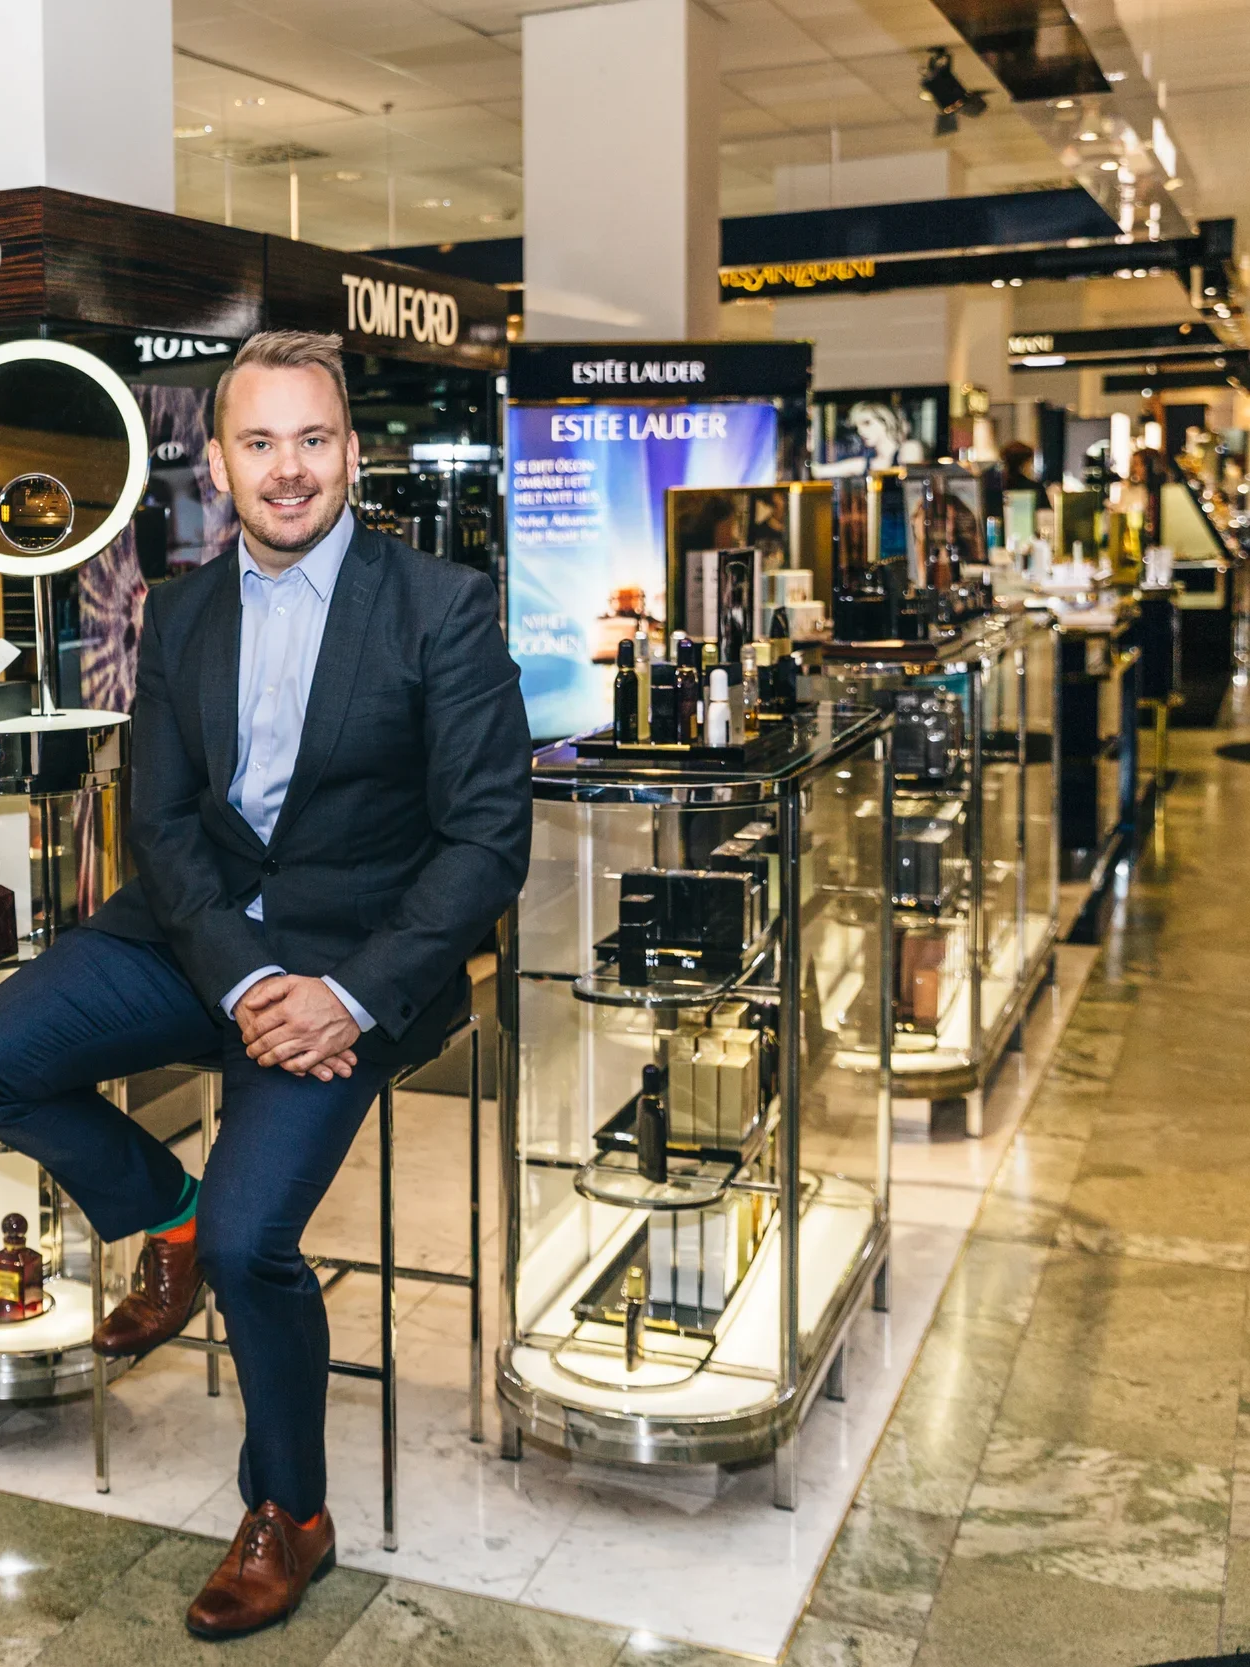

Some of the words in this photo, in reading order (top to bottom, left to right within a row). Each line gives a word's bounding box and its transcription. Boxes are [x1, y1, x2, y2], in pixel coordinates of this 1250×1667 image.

[342, 273, 397, 337] TOM
[398, 285, 459, 346] FORD
[630, 361, 706, 384] LAUDER
[628, 412, 728, 441] LAUDER
